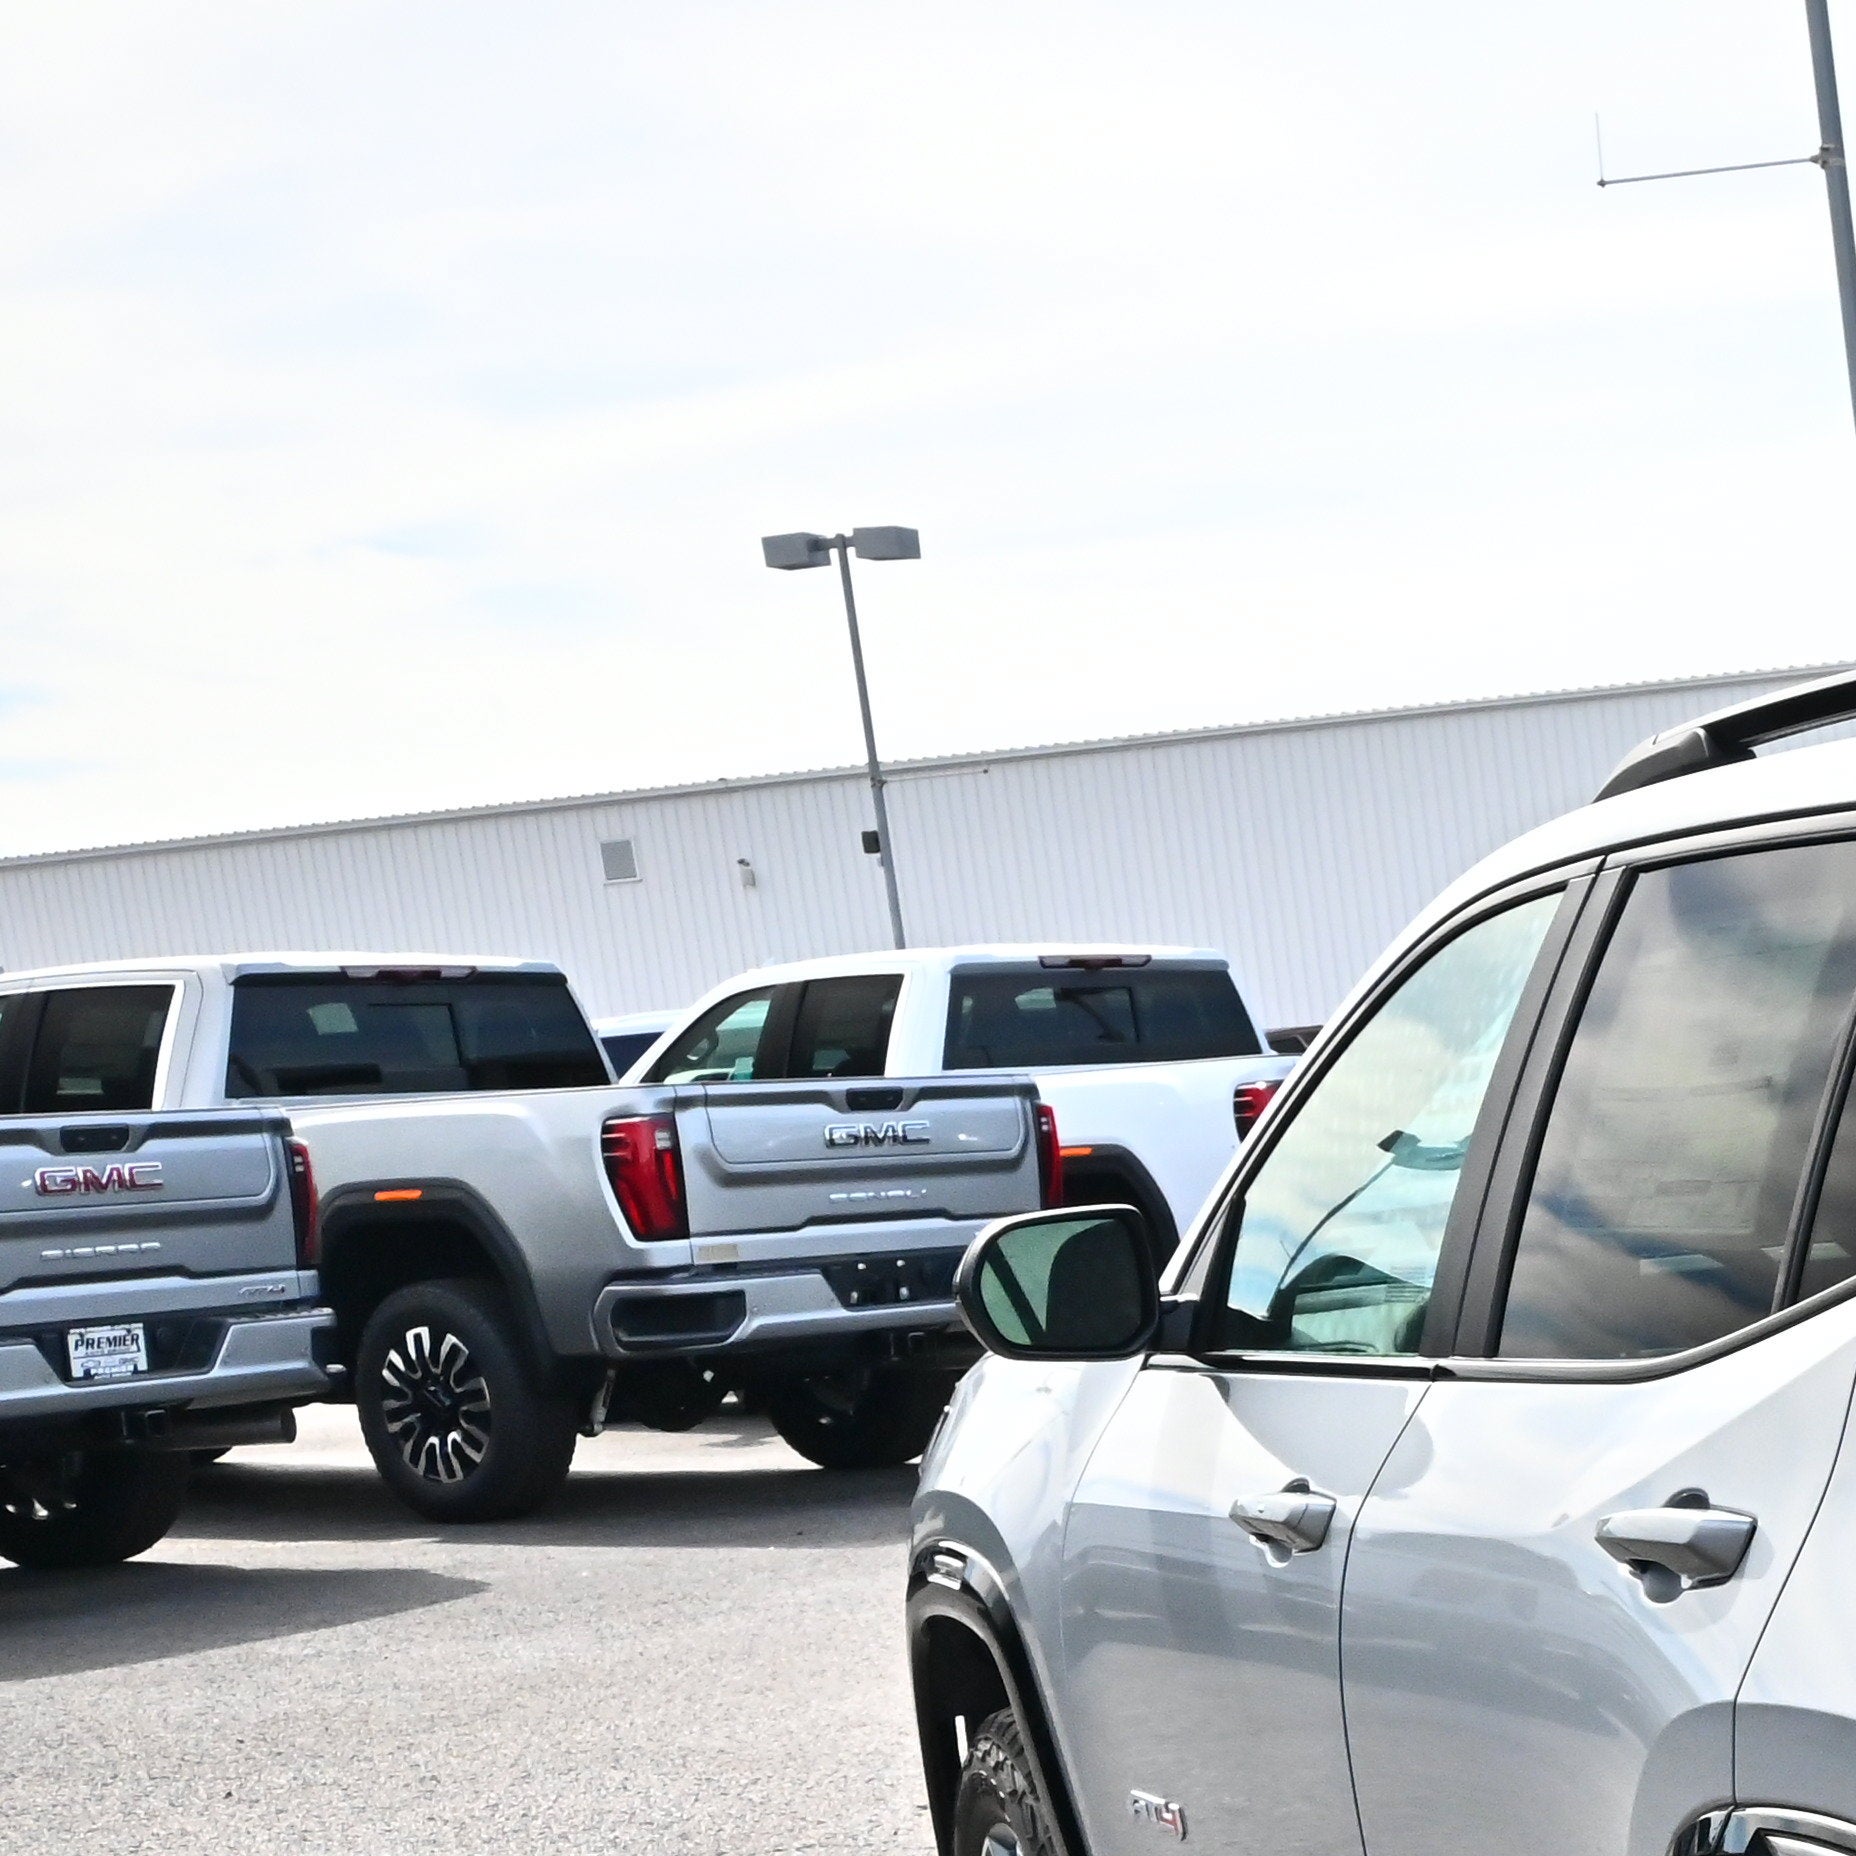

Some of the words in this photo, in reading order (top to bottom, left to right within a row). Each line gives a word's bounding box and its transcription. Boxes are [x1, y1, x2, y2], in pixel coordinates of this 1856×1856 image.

[824, 1120, 930, 1148] GMC
[34, 1161, 164, 1196] GMC
[74, 1333, 141, 1352] PREMIER
